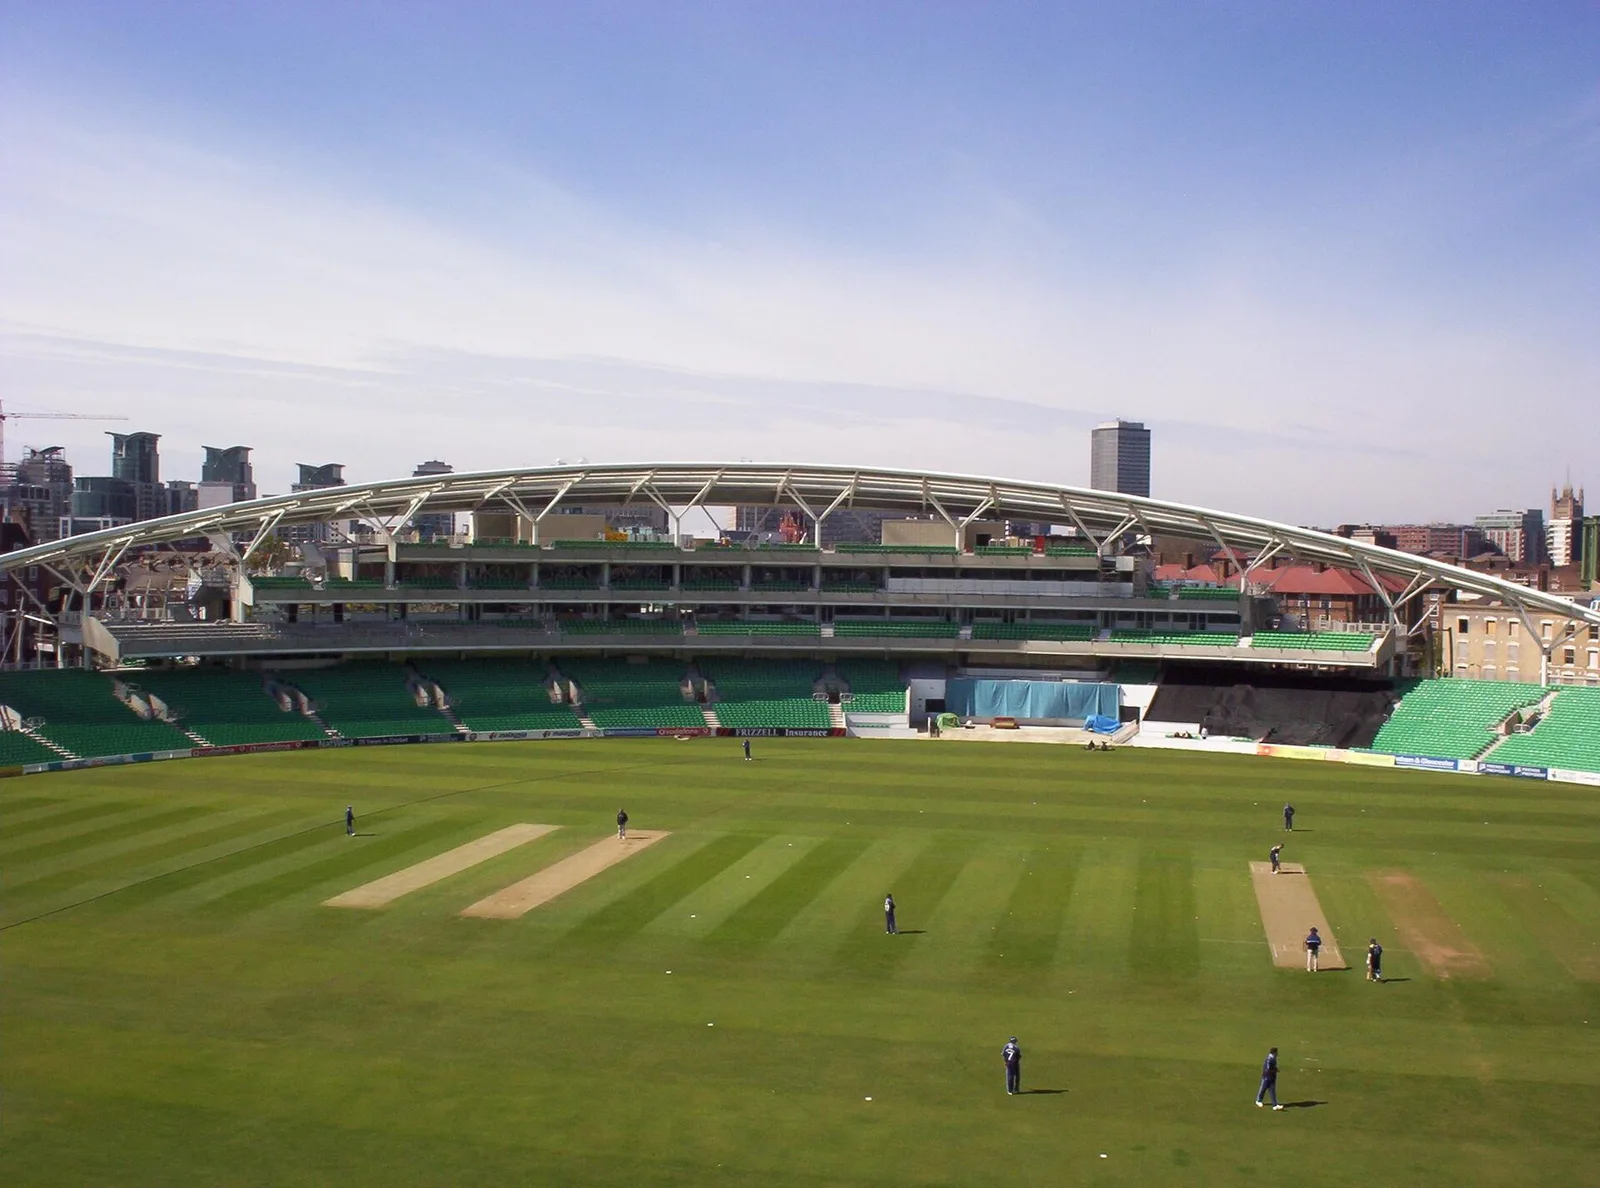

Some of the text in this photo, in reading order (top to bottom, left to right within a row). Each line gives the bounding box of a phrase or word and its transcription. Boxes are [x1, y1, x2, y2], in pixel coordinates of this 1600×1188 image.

[735, 728, 828, 737] FRIZZELL Insurance
[1007, 1051, 1014, 1061] 7
